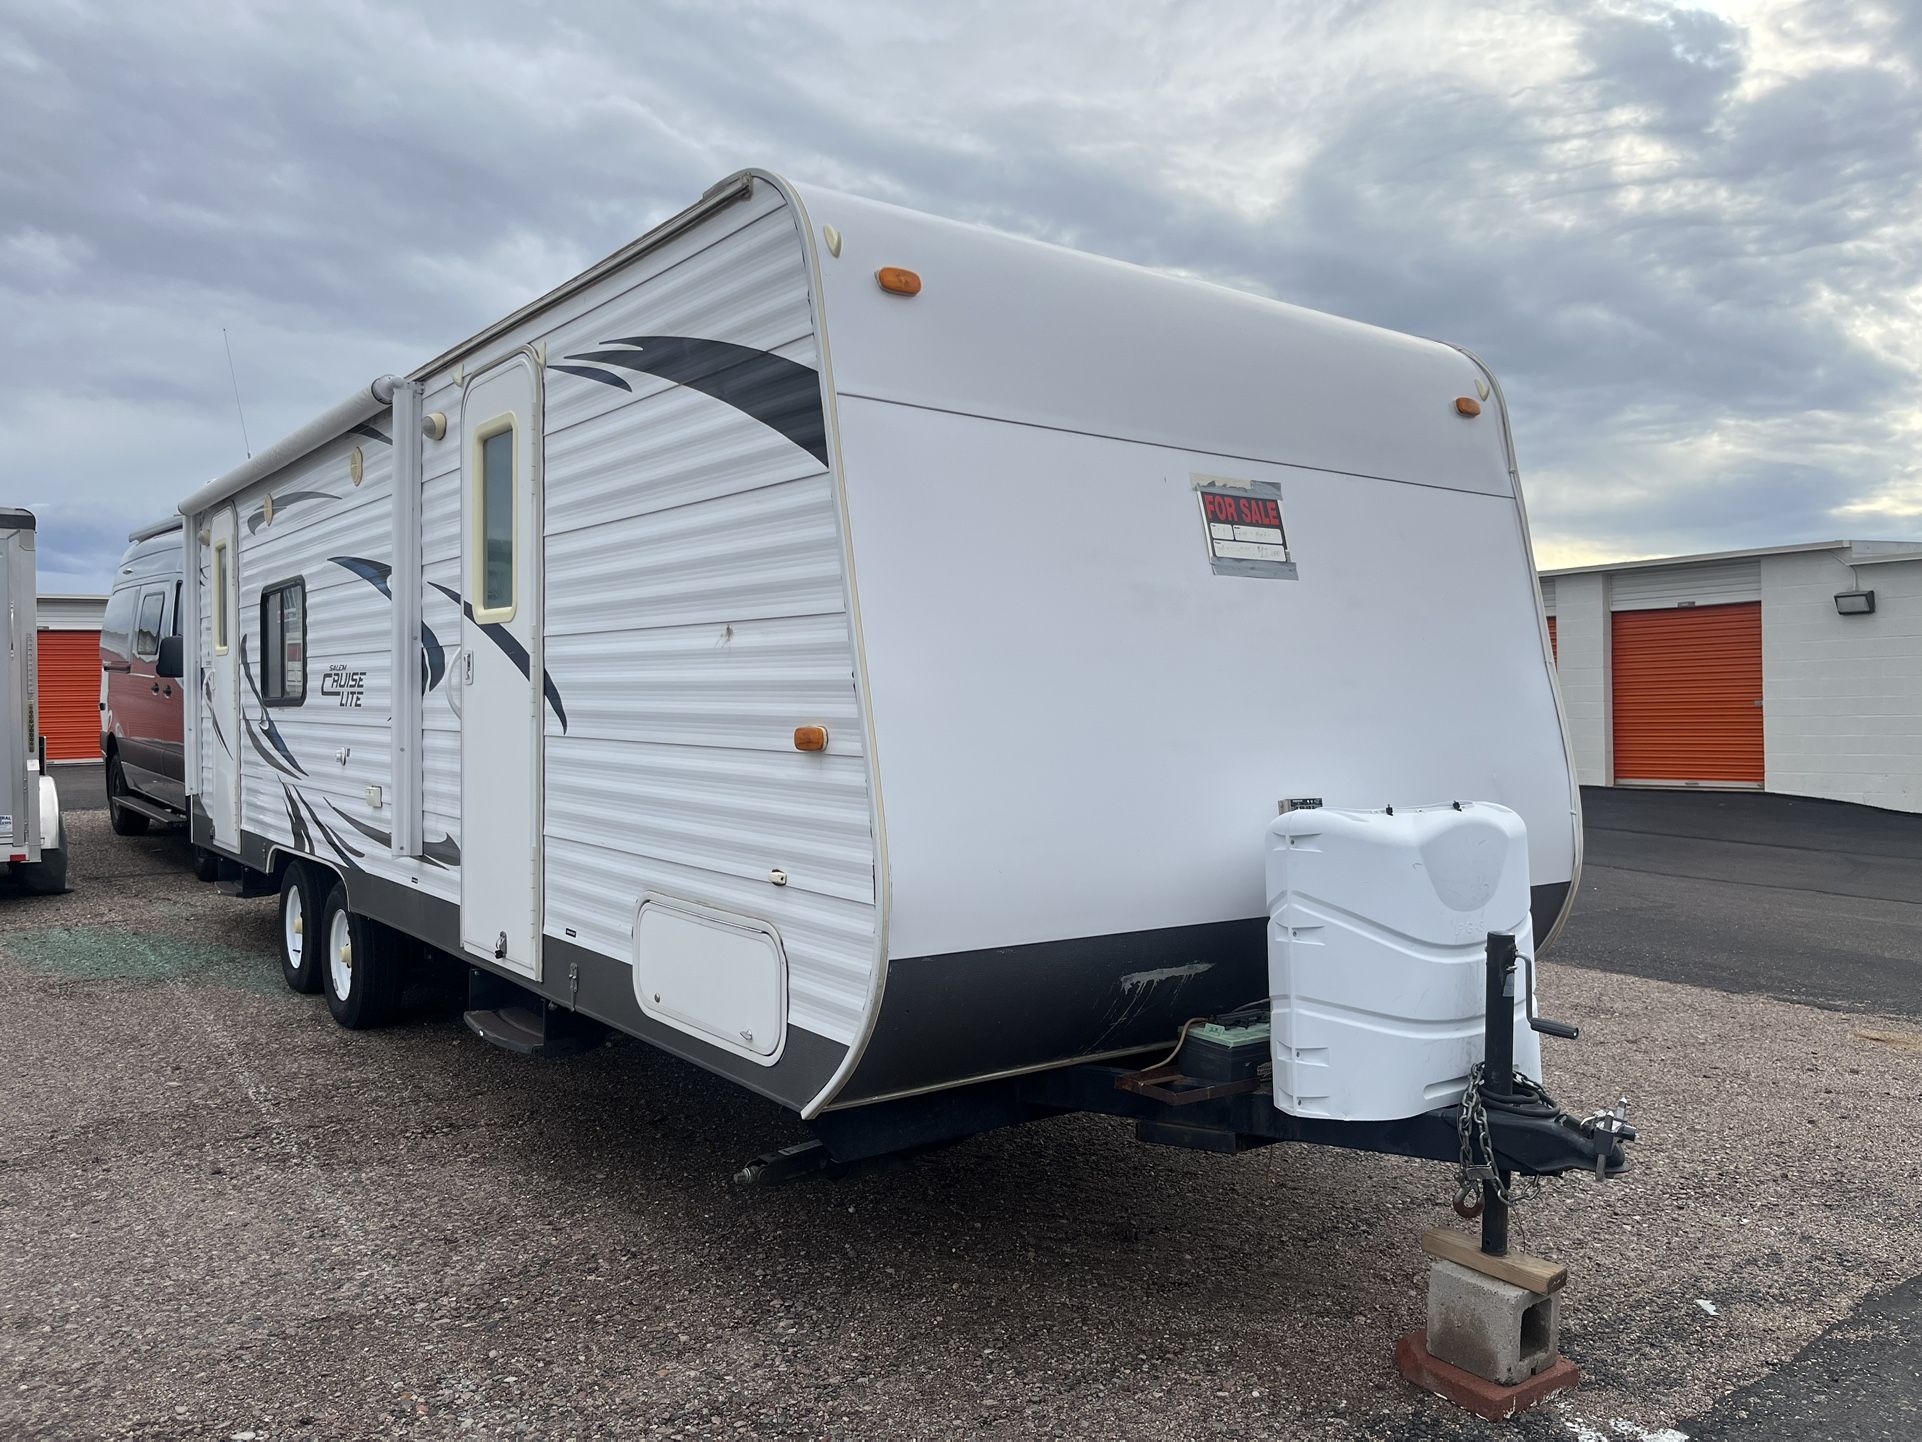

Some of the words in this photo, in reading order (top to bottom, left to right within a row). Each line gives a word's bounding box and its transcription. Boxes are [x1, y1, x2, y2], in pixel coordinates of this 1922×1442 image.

[1204, 494, 1238, 522] FOR
[1239, 499, 1281, 526] SALE
[321, 672, 367, 696] CRUISE
[340, 691, 364, 707] LITE
